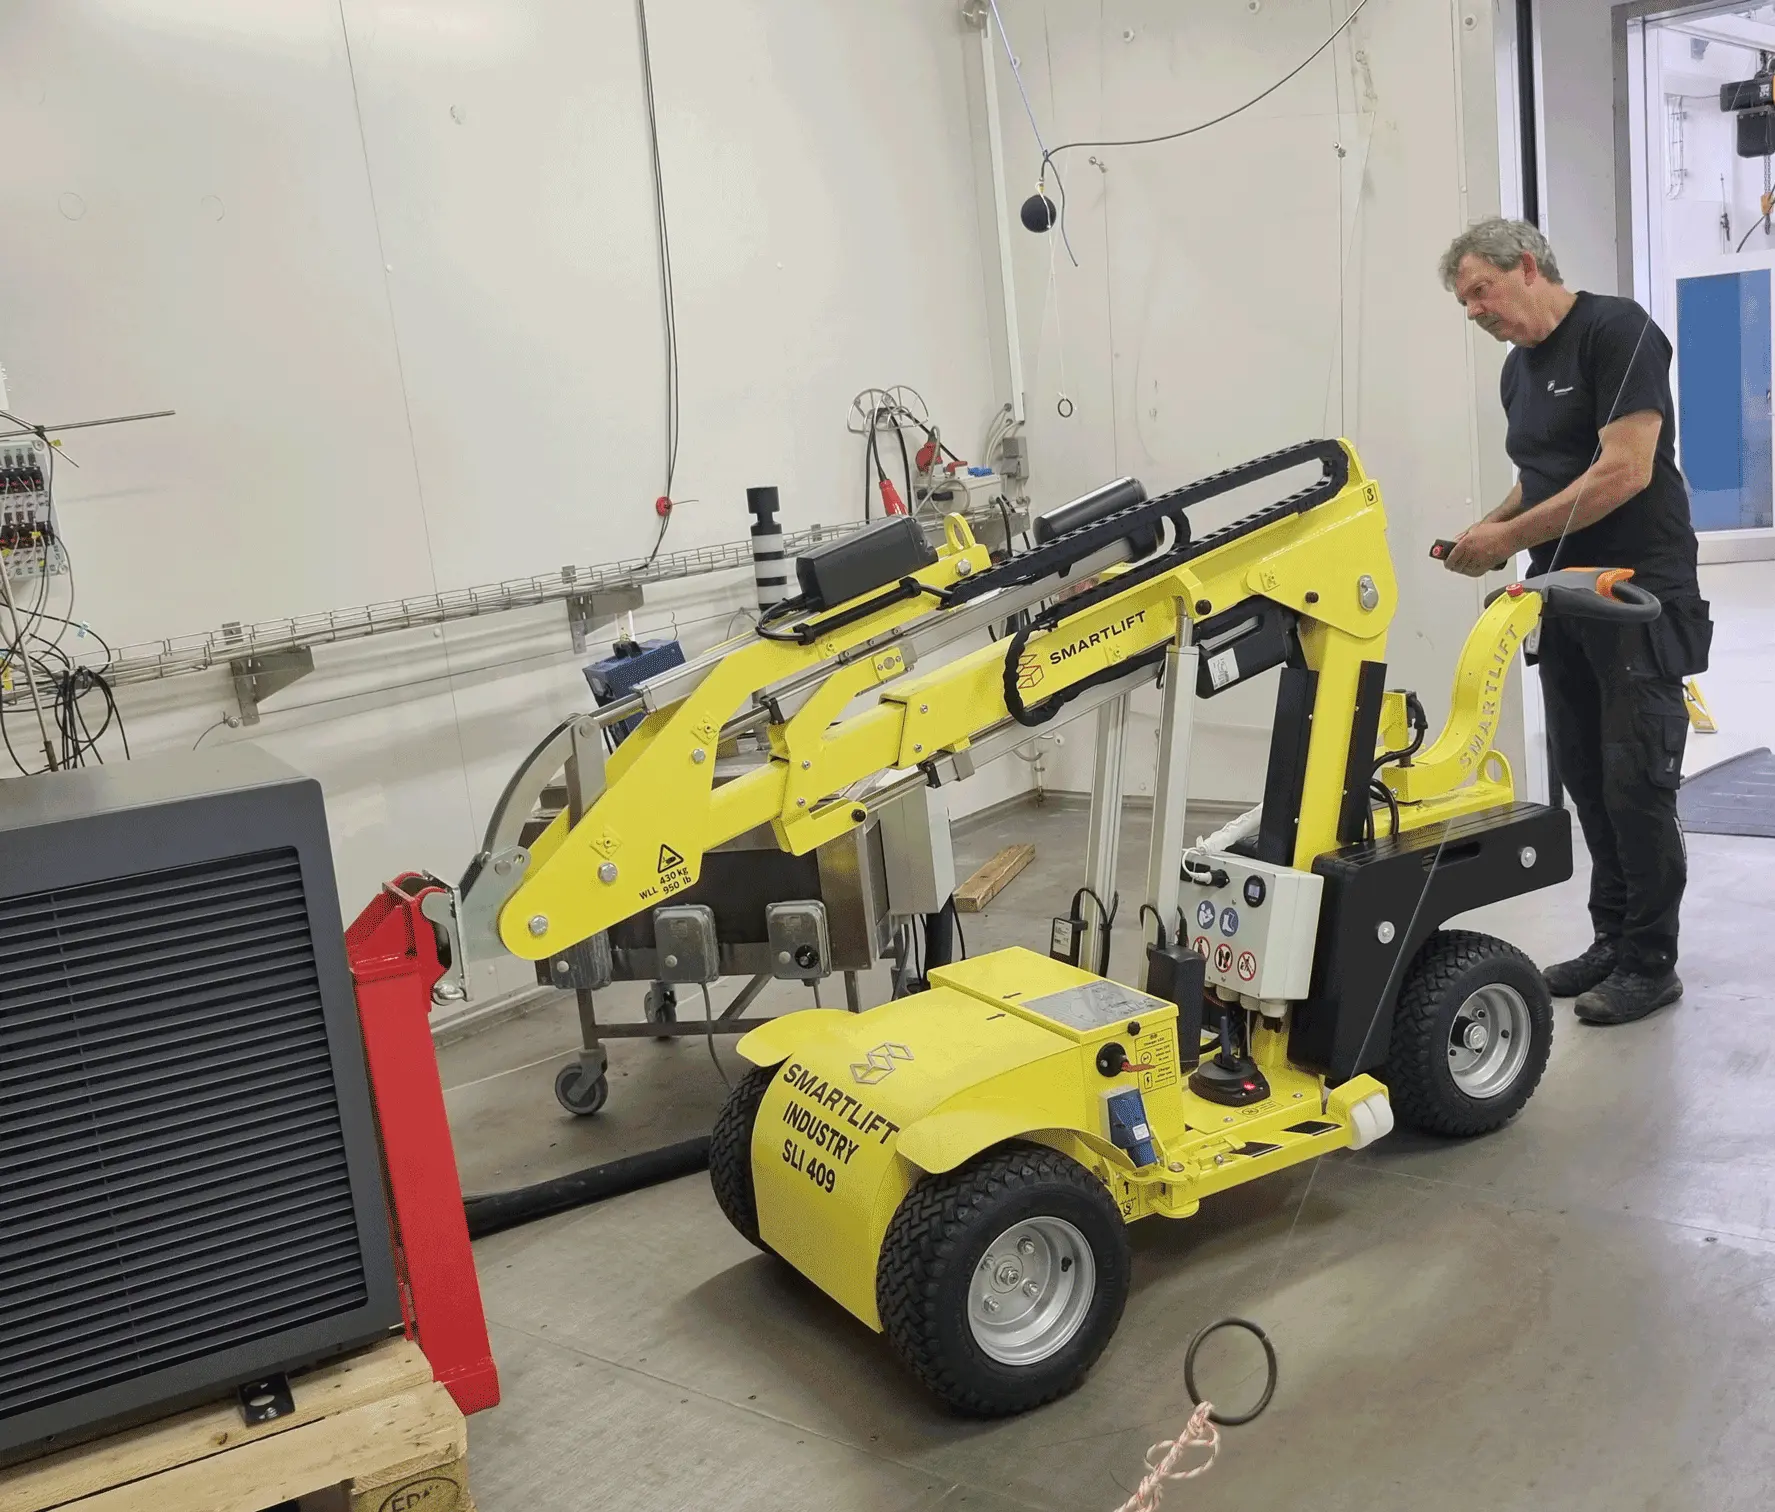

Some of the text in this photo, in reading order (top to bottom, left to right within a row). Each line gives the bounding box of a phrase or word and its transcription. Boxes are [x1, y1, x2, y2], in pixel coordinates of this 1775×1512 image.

[1049, 610, 1146, 665] SMARTLIFT
[1459, 623, 1519, 769] SMARTLIFT
[639, 876, 692, 900] WLL 950 lb
[660, 867, 689, 884] 430 kg
[783, 1063, 900, 1144] SMARTLIFT
[782, 1100, 860, 1165] INDUSTRY
[782, 1138, 836, 1193] SLI 409
